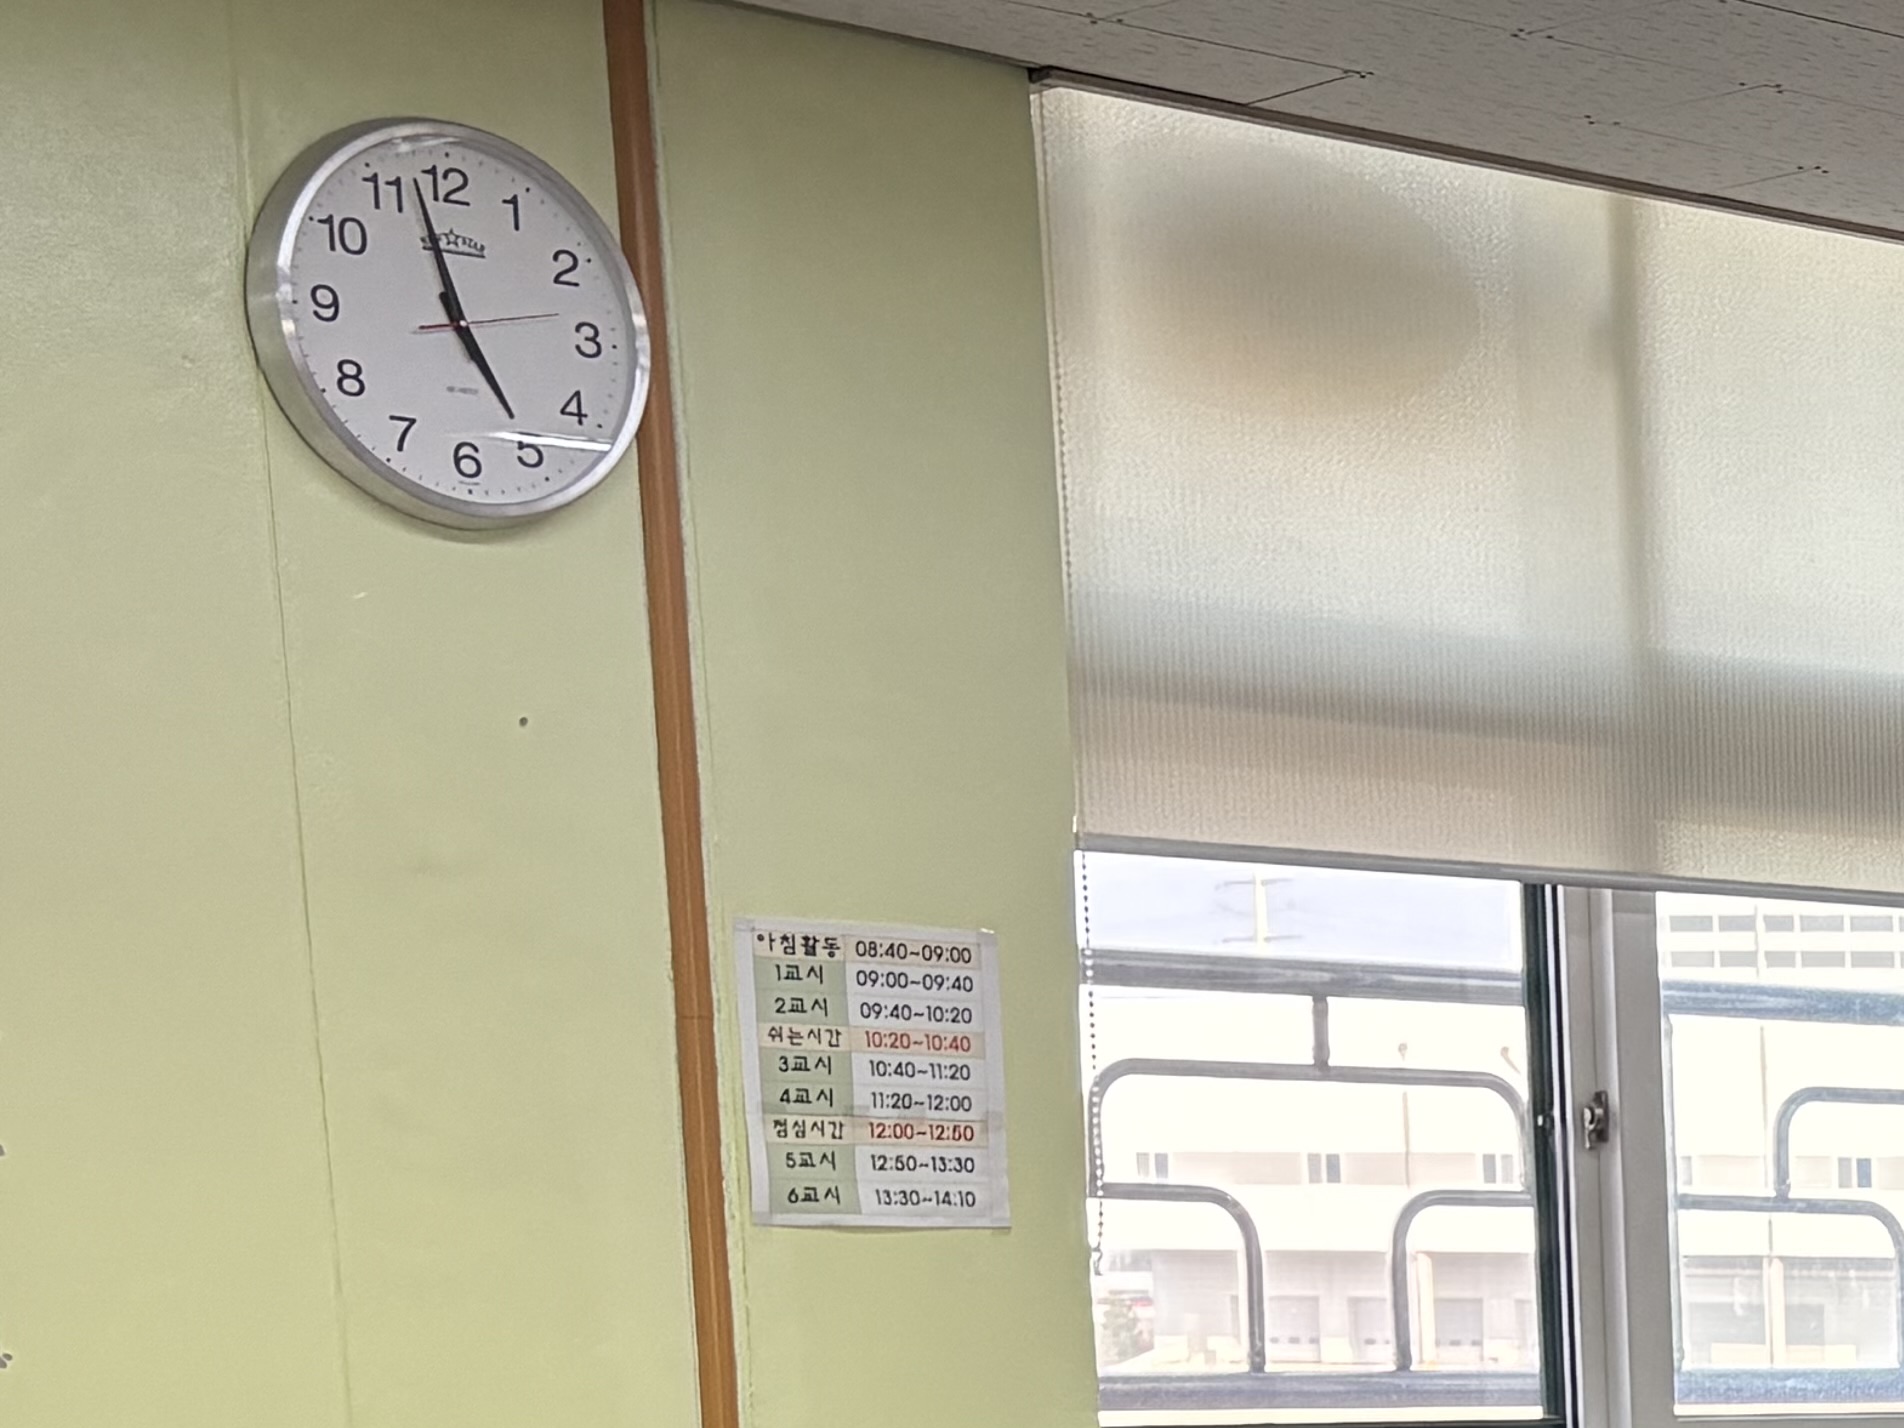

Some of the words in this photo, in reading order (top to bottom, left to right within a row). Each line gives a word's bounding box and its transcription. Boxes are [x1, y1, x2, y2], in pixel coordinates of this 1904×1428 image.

[362, 172, 404, 214] 11
[421, 165, 470, 206] 12
[501, 194, 520, 231] 1
[317, 215, 367, 255] 10
[552, 249, 580, 287] 2
[310, 284, 340, 321] 9
[574, 322, 602, 359] 3
[336, 359, 366, 396] 8
[559, 390, 588, 426] 4
[389, 415, 417, 451] 7
[453, 442, 482, 478] 6
[516, 440, 545, 468] 5
[756, 934, 841, 958] 아침활동
[774, 964, 824, 985] 1교시
[774, 997, 829, 1017] 2교시
[767, 1026, 842, 1048] 쉬는시간
[778, 1056, 832, 1075] 3교시
[779, 1087, 834, 1107] 4교시
[772, 1118, 845, 1139] 점심시간
[785, 1151, 837, 1171] 5교시
[788, 1186, 841, 1205] 6교시
